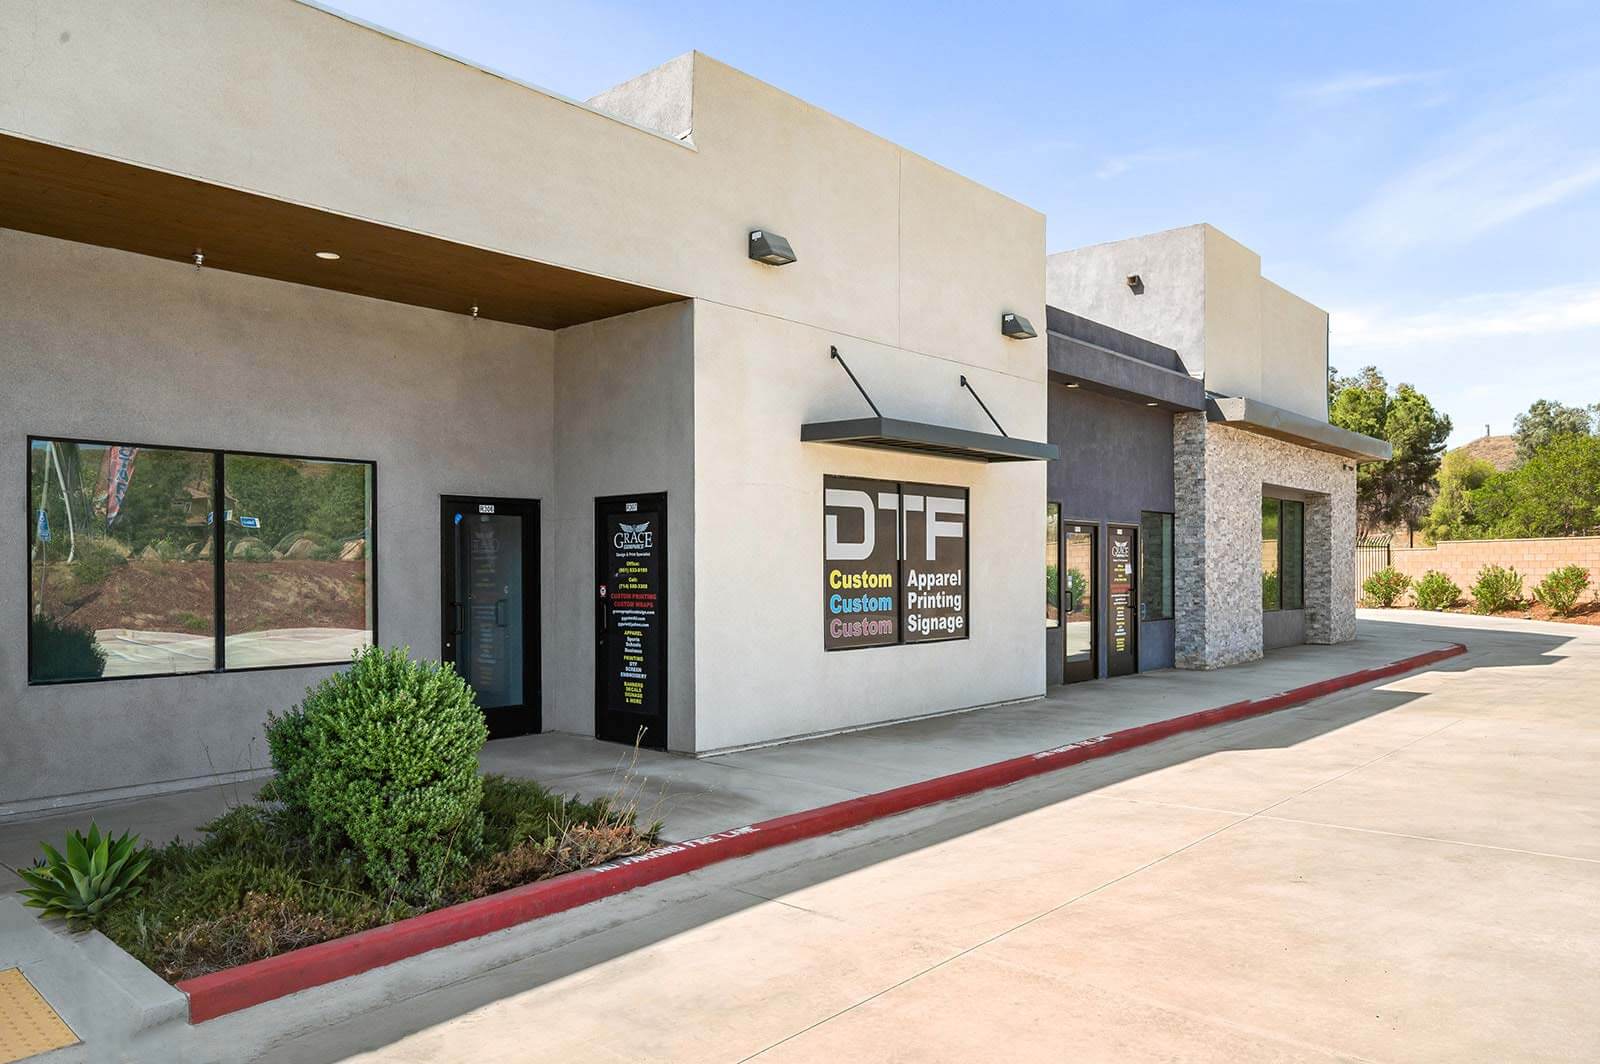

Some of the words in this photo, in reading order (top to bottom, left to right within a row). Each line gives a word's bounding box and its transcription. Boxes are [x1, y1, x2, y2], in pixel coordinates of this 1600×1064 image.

[825, 488, 966, 561] DTF
[614, 532, 653, 549] GRACE
[829, 569, 892, 589] Custom
[907, 569, 961, 590] Apparel
[829, 593, 892, 614] Custom
[908, 591, 962, 612] Printing
[830, 617, 892, 638] Custom
[907, 615, 964, 635] Signage
[622, 844, 687, 866] PARKING
